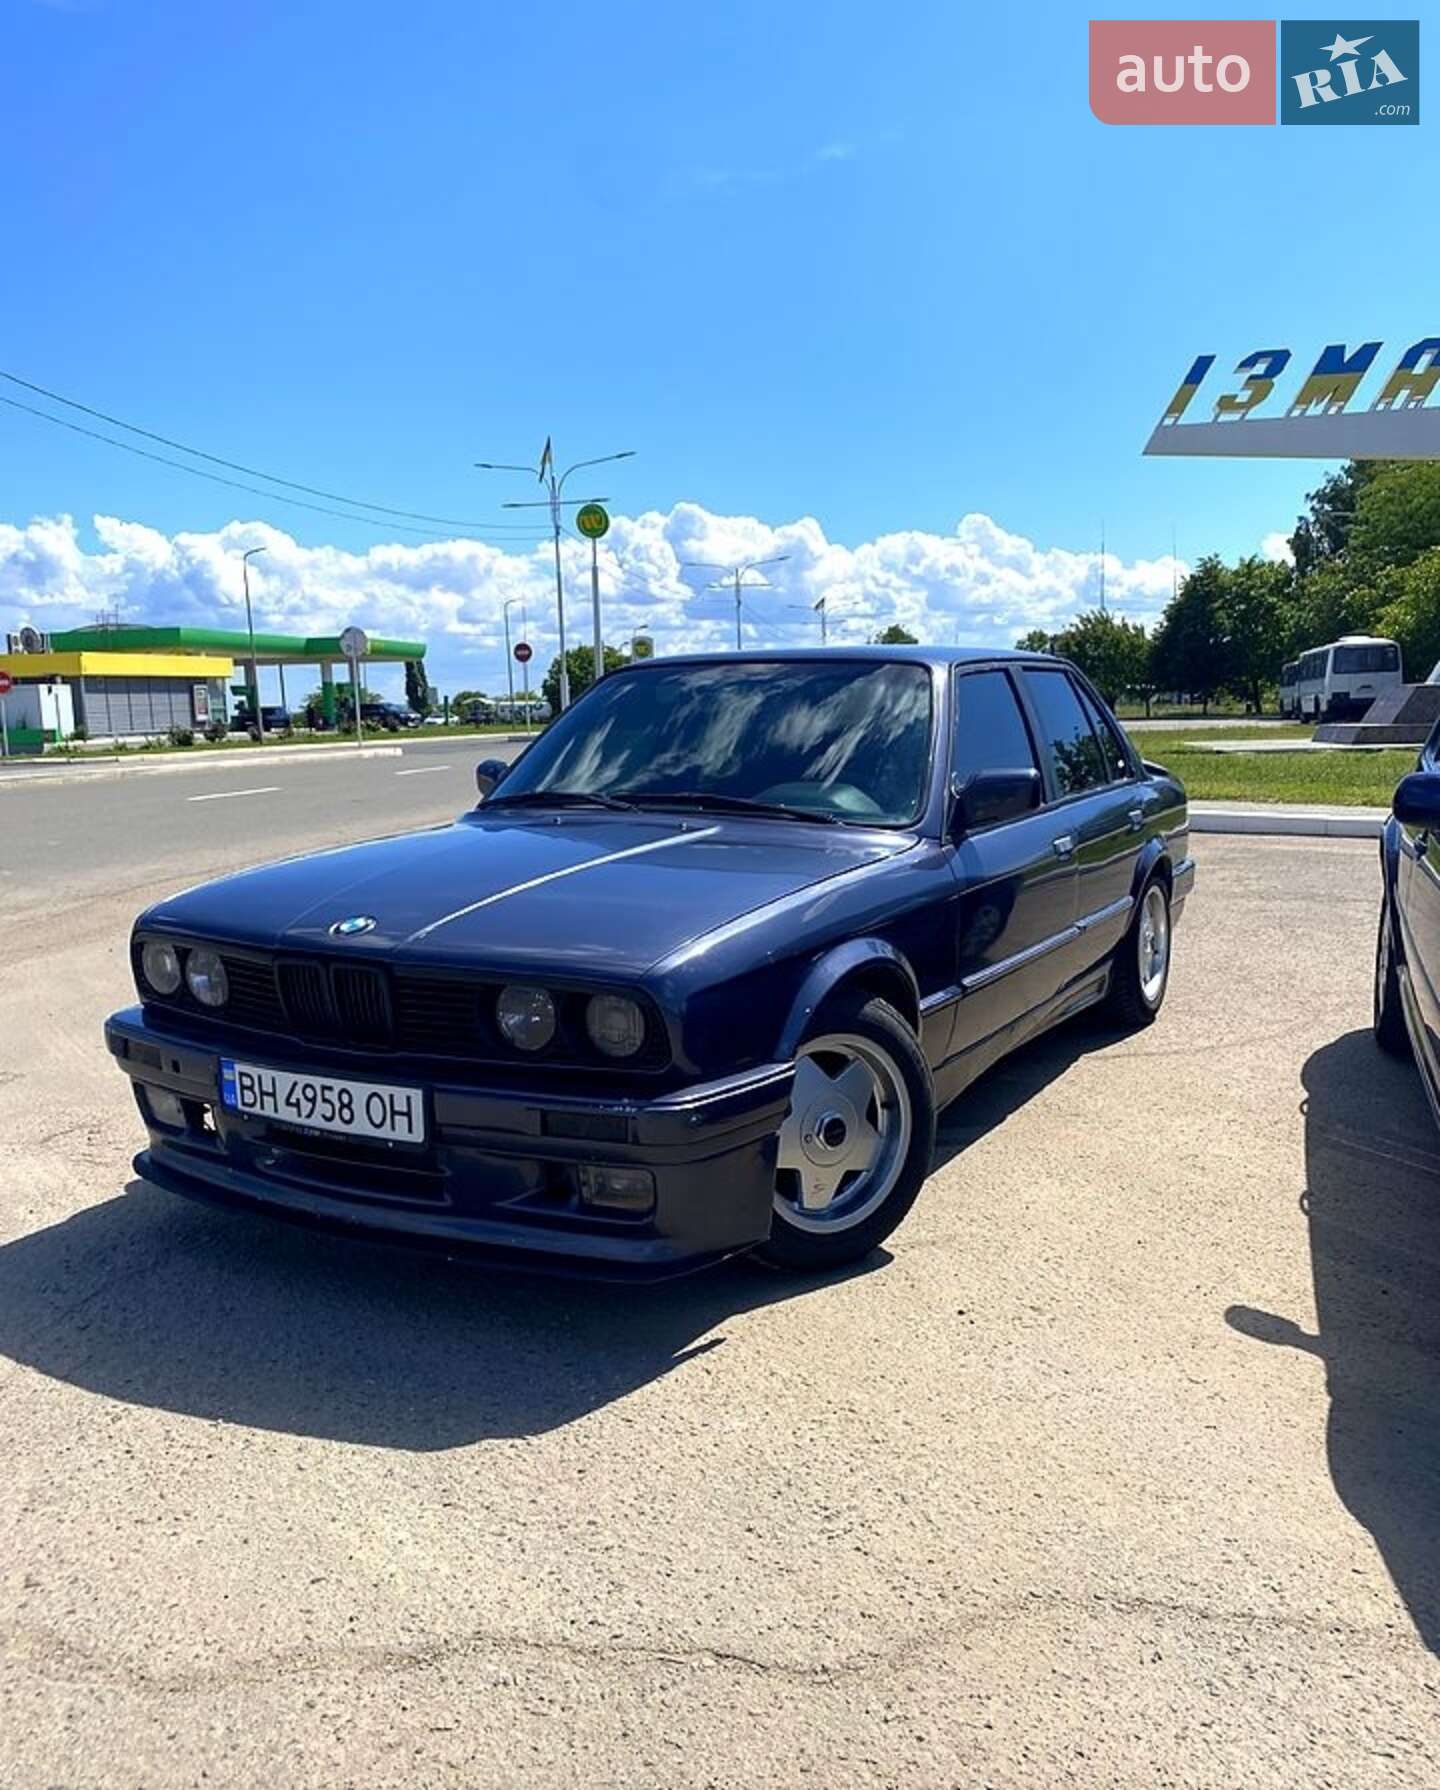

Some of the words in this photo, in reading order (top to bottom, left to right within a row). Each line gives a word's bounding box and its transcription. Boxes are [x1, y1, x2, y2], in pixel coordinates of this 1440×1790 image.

[237, 1070, 279, 1114] BH
[285, 1080, 355, 1125] 4958
[365, 1091, 414, 1134] OH
